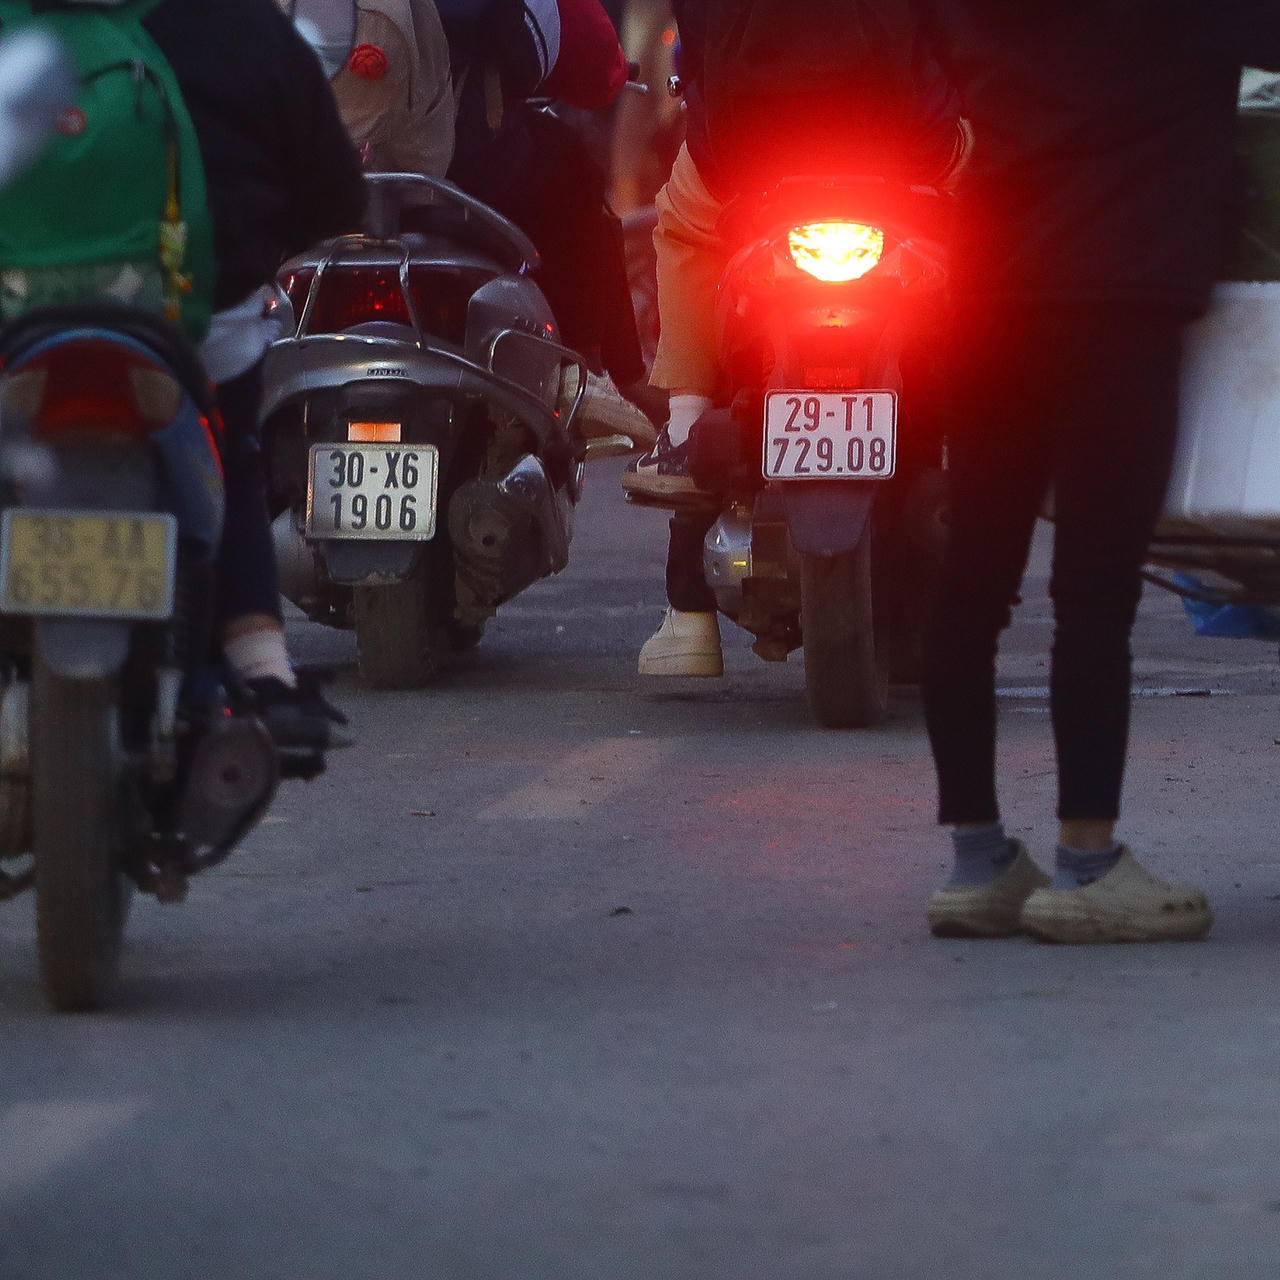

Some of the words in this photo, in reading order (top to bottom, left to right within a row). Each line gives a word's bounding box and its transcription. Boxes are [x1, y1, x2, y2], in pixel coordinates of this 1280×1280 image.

[784, 396, 874, 433] 29-T1
[328, 450, 419, 489] 30-X6
[772, 436, 886, 474] 729.08
[330, 492, 418, 531] 1906
